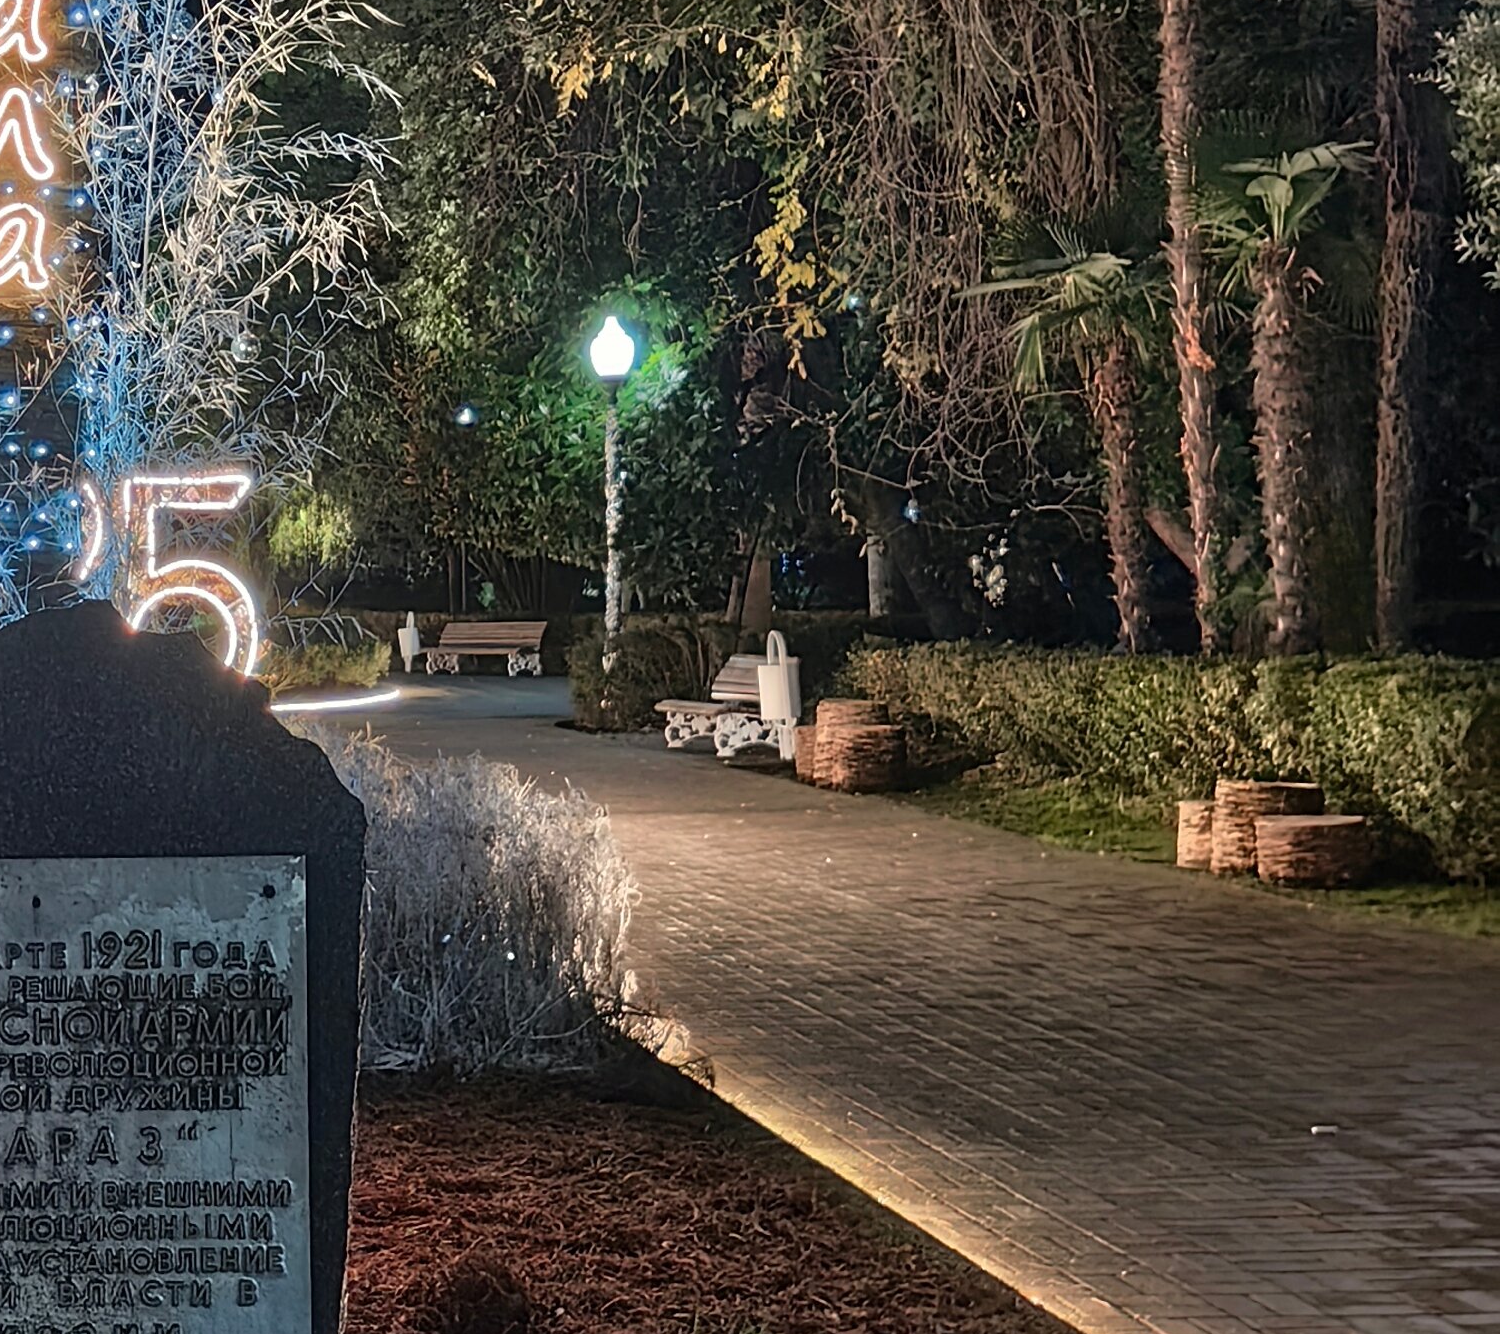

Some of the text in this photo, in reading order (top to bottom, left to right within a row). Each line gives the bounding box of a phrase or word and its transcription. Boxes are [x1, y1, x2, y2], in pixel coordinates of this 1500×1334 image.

[82, 929, 162, 969] 1921
[173, 940, 276, 969] ГОДА
[8, 974, 197, 1003] РЕШАЮЩИЕ
[139, 1007, 288, 1045] АРМИИ
[67, 1085, 244, 1114] ДРУЖИНЫ
[68, 1182, 92, 1208] И
[101, 1179, 292, 1209] ВНЕШНИМИ
[16, 1246, 285, 1276] УСТАНОВЛЕНИЕ
[57, 1279, 212, 1309] ВЛАСТИ
[237, 1278, 259, 1307] В
